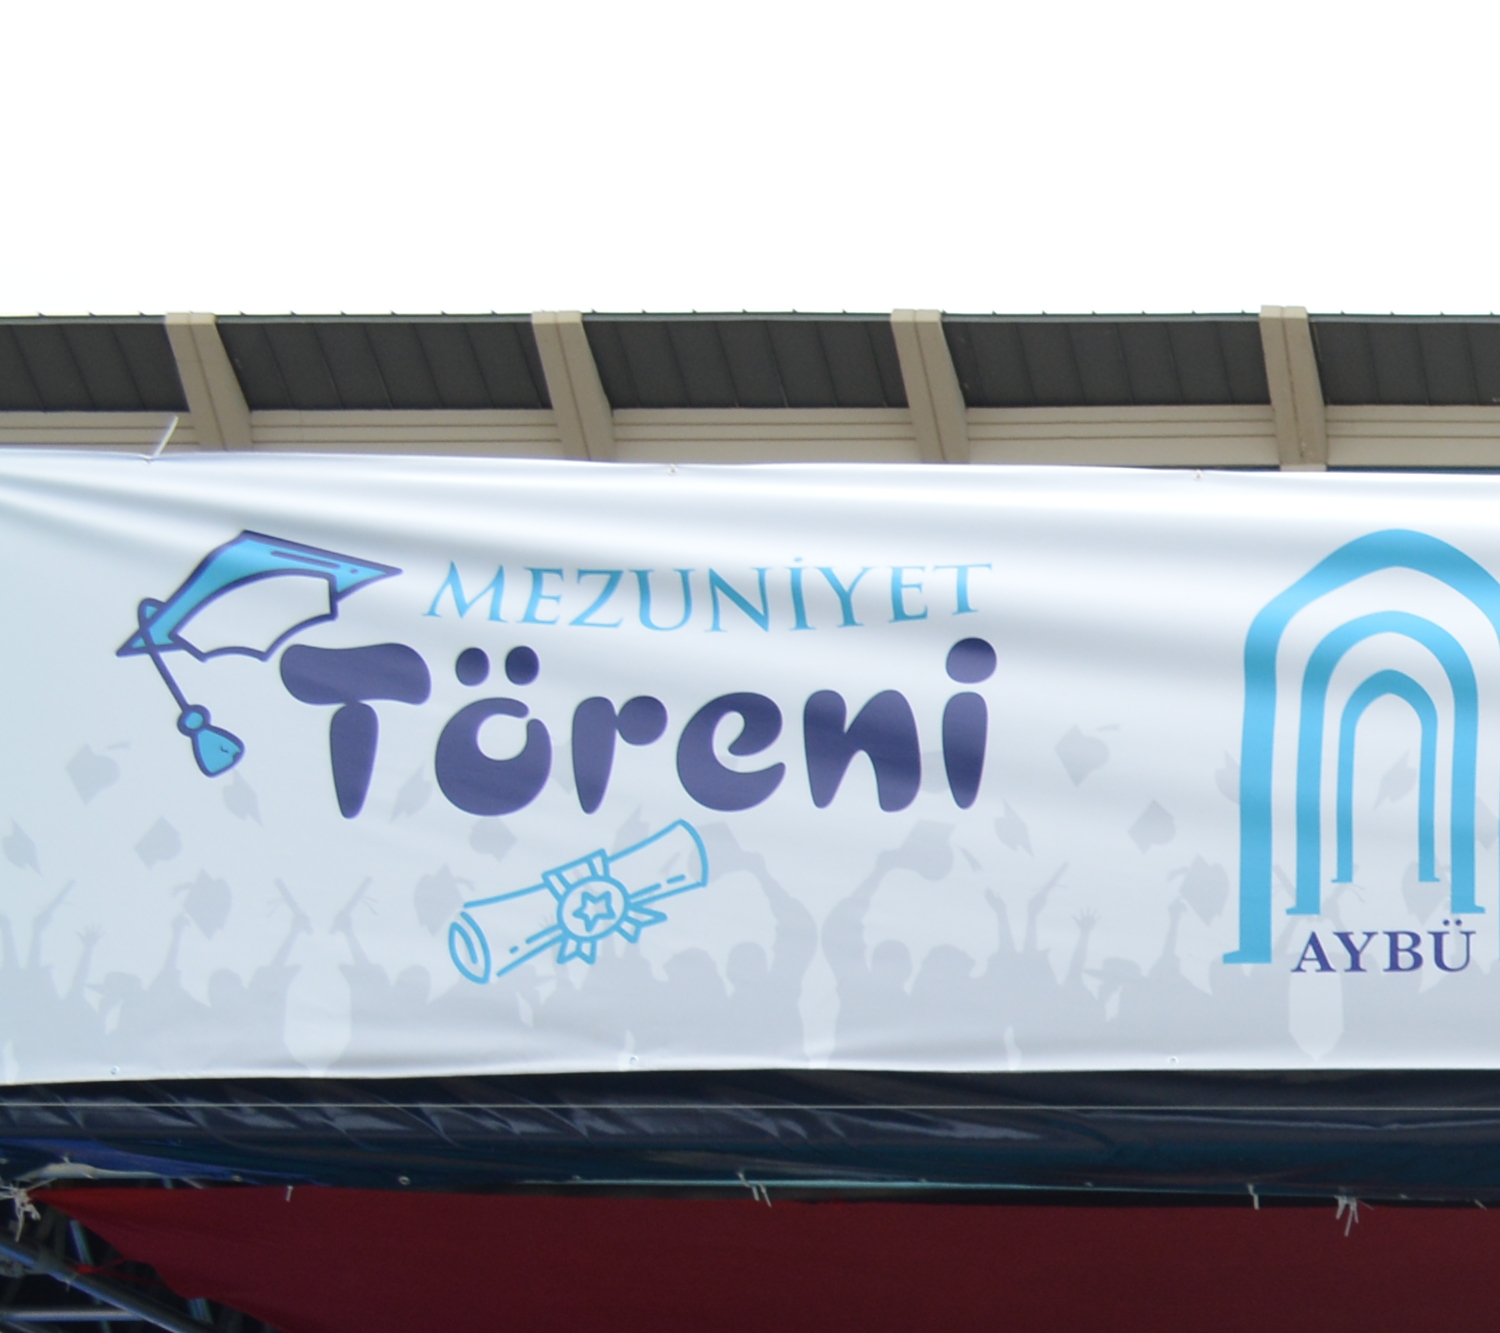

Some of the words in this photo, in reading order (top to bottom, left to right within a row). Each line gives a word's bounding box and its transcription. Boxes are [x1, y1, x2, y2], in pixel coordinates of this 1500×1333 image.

[422, 556, 996, 632] MEZUNİYET
[280, 636, 998, 819] Töreni
[1290, 918, 1476, 974] AYBÜ
